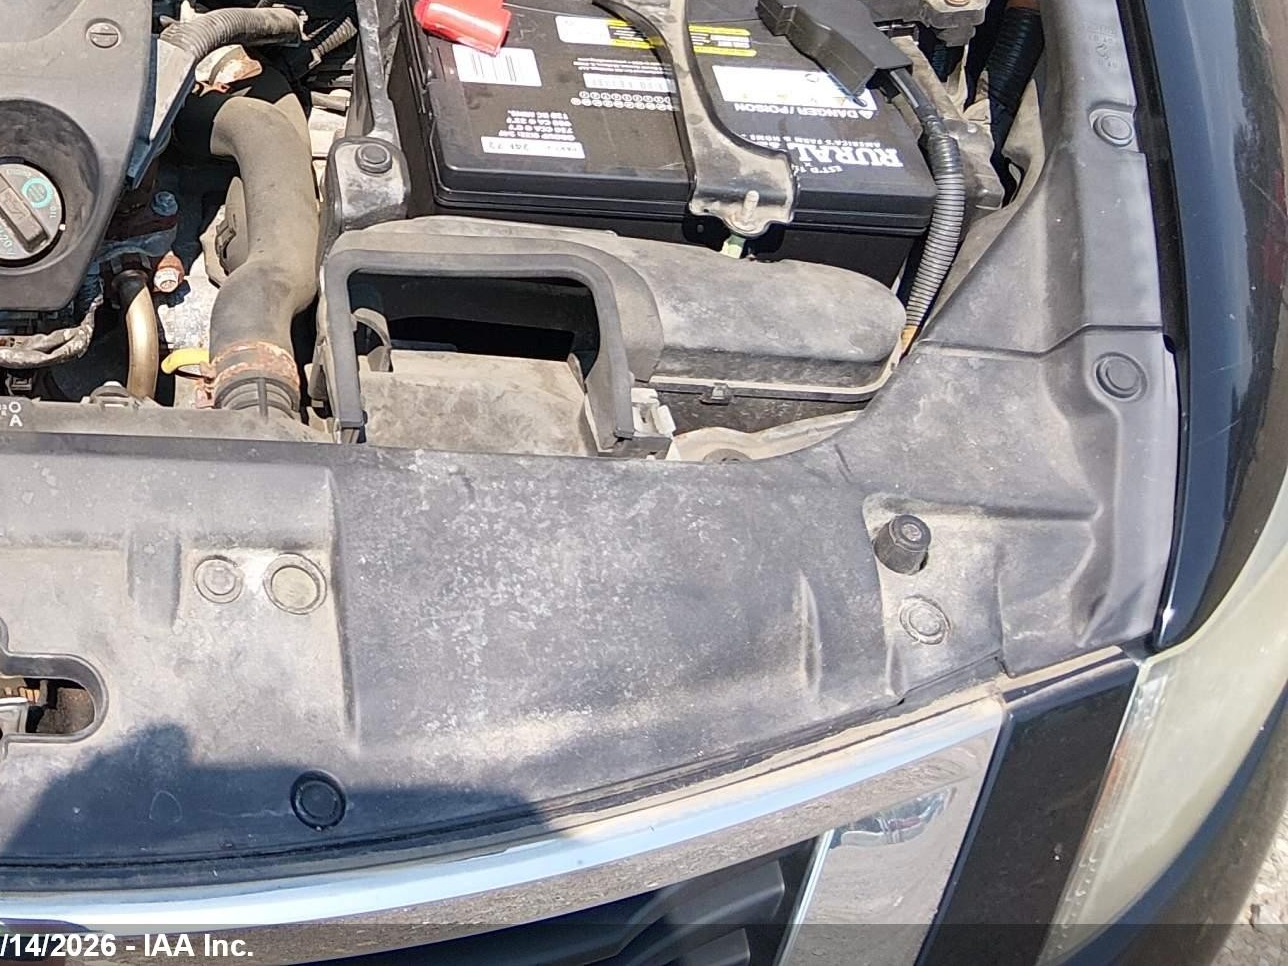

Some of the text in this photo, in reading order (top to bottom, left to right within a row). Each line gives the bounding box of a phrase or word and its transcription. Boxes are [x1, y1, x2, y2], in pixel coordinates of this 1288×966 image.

[734, 103, 790, 114] POISON
[797, 107, 859, 119] DANGER
[824, 139, 881, 148] AMERICA'S
[786, 142, 904, 167] RURAL
[9, 414, 23, 427] A
